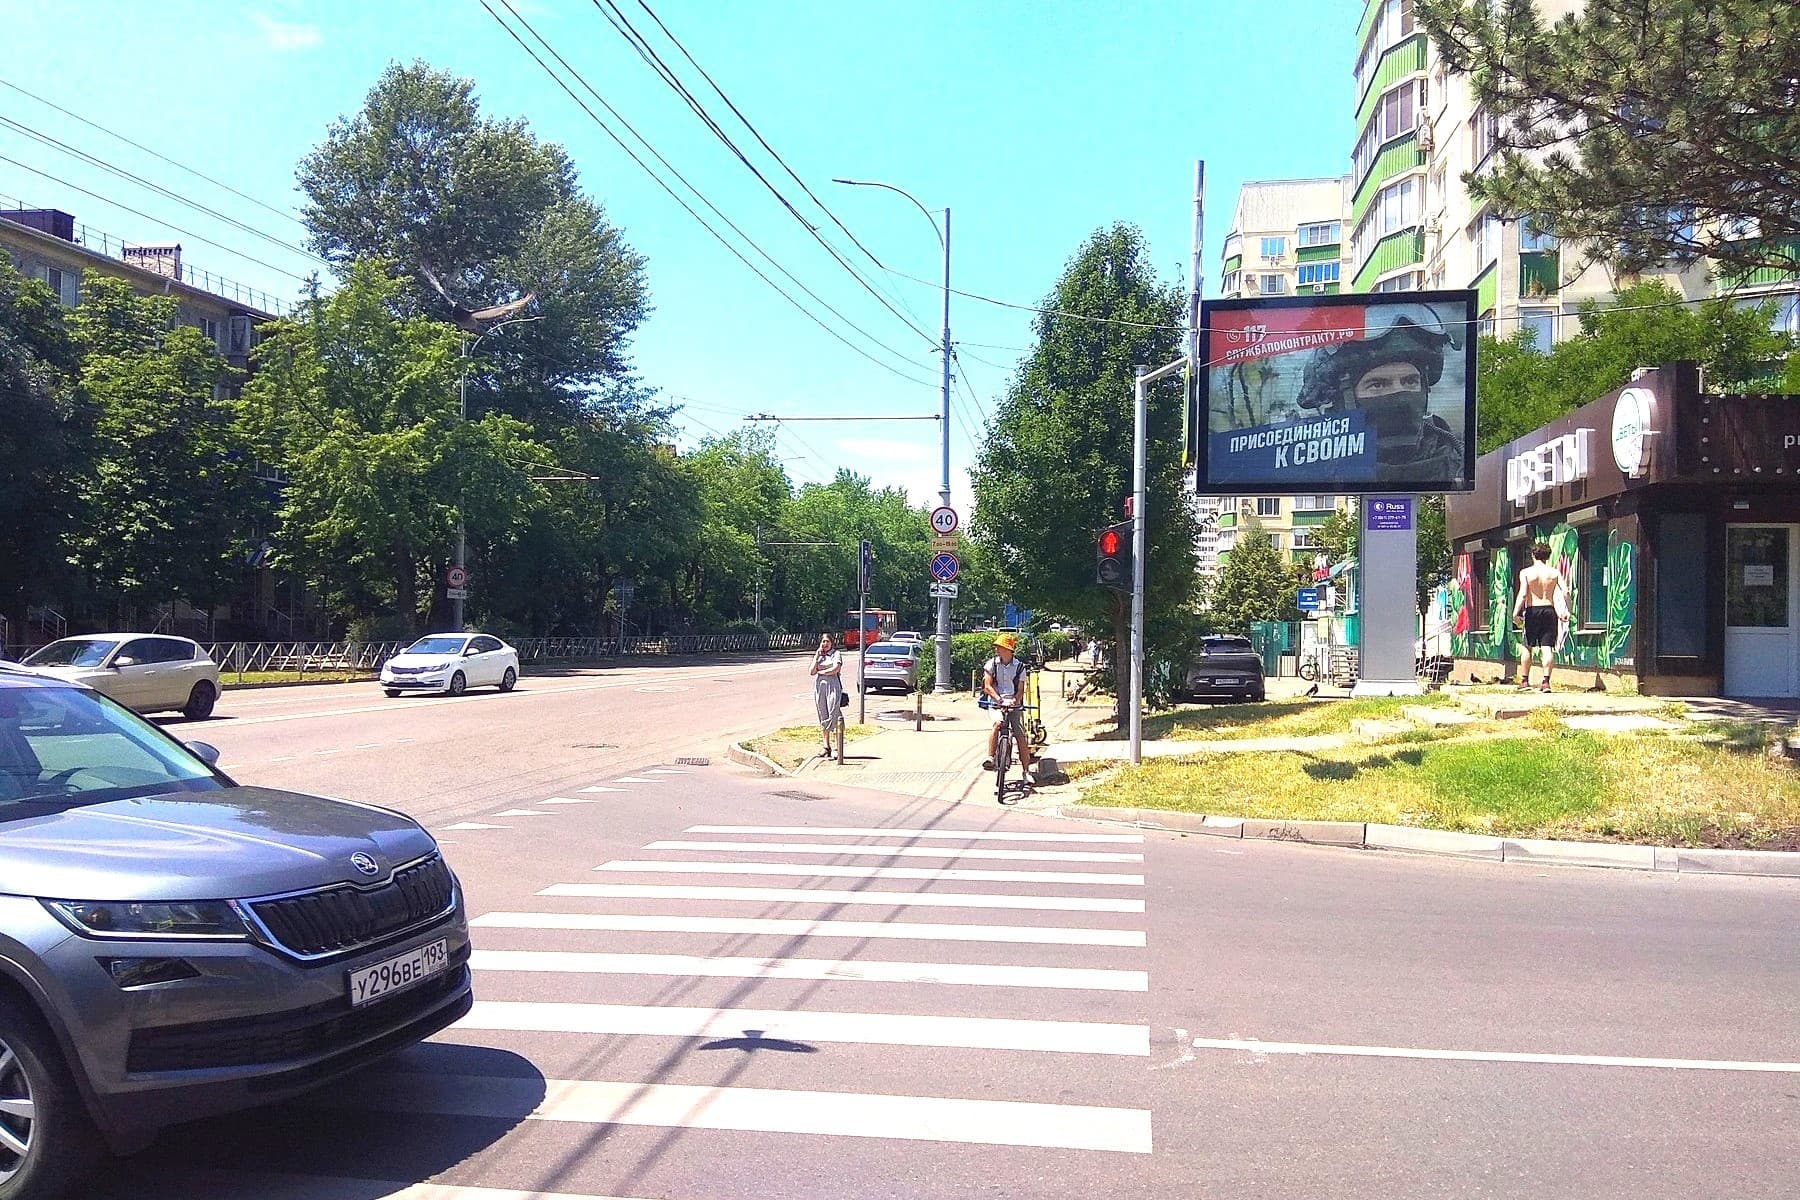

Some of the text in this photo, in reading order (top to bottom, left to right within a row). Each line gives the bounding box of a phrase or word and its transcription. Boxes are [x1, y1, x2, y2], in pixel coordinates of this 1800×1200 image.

[1226, 329, 1354, 360] СЛУЖБАПОКОНТРАКТУ.РФ
[1243, 325, 1266, 343] 117
[1230, 417, 1350, 452] ПРИСОЕДИНЯЙСЯ
[1275, 432, 1365, 469] К СВОИМ
[1507, 428, 1588, 507] ЦВЕТЫ
[935, 514, 953, 526] 40
[452, 572, 463, 580] 40
